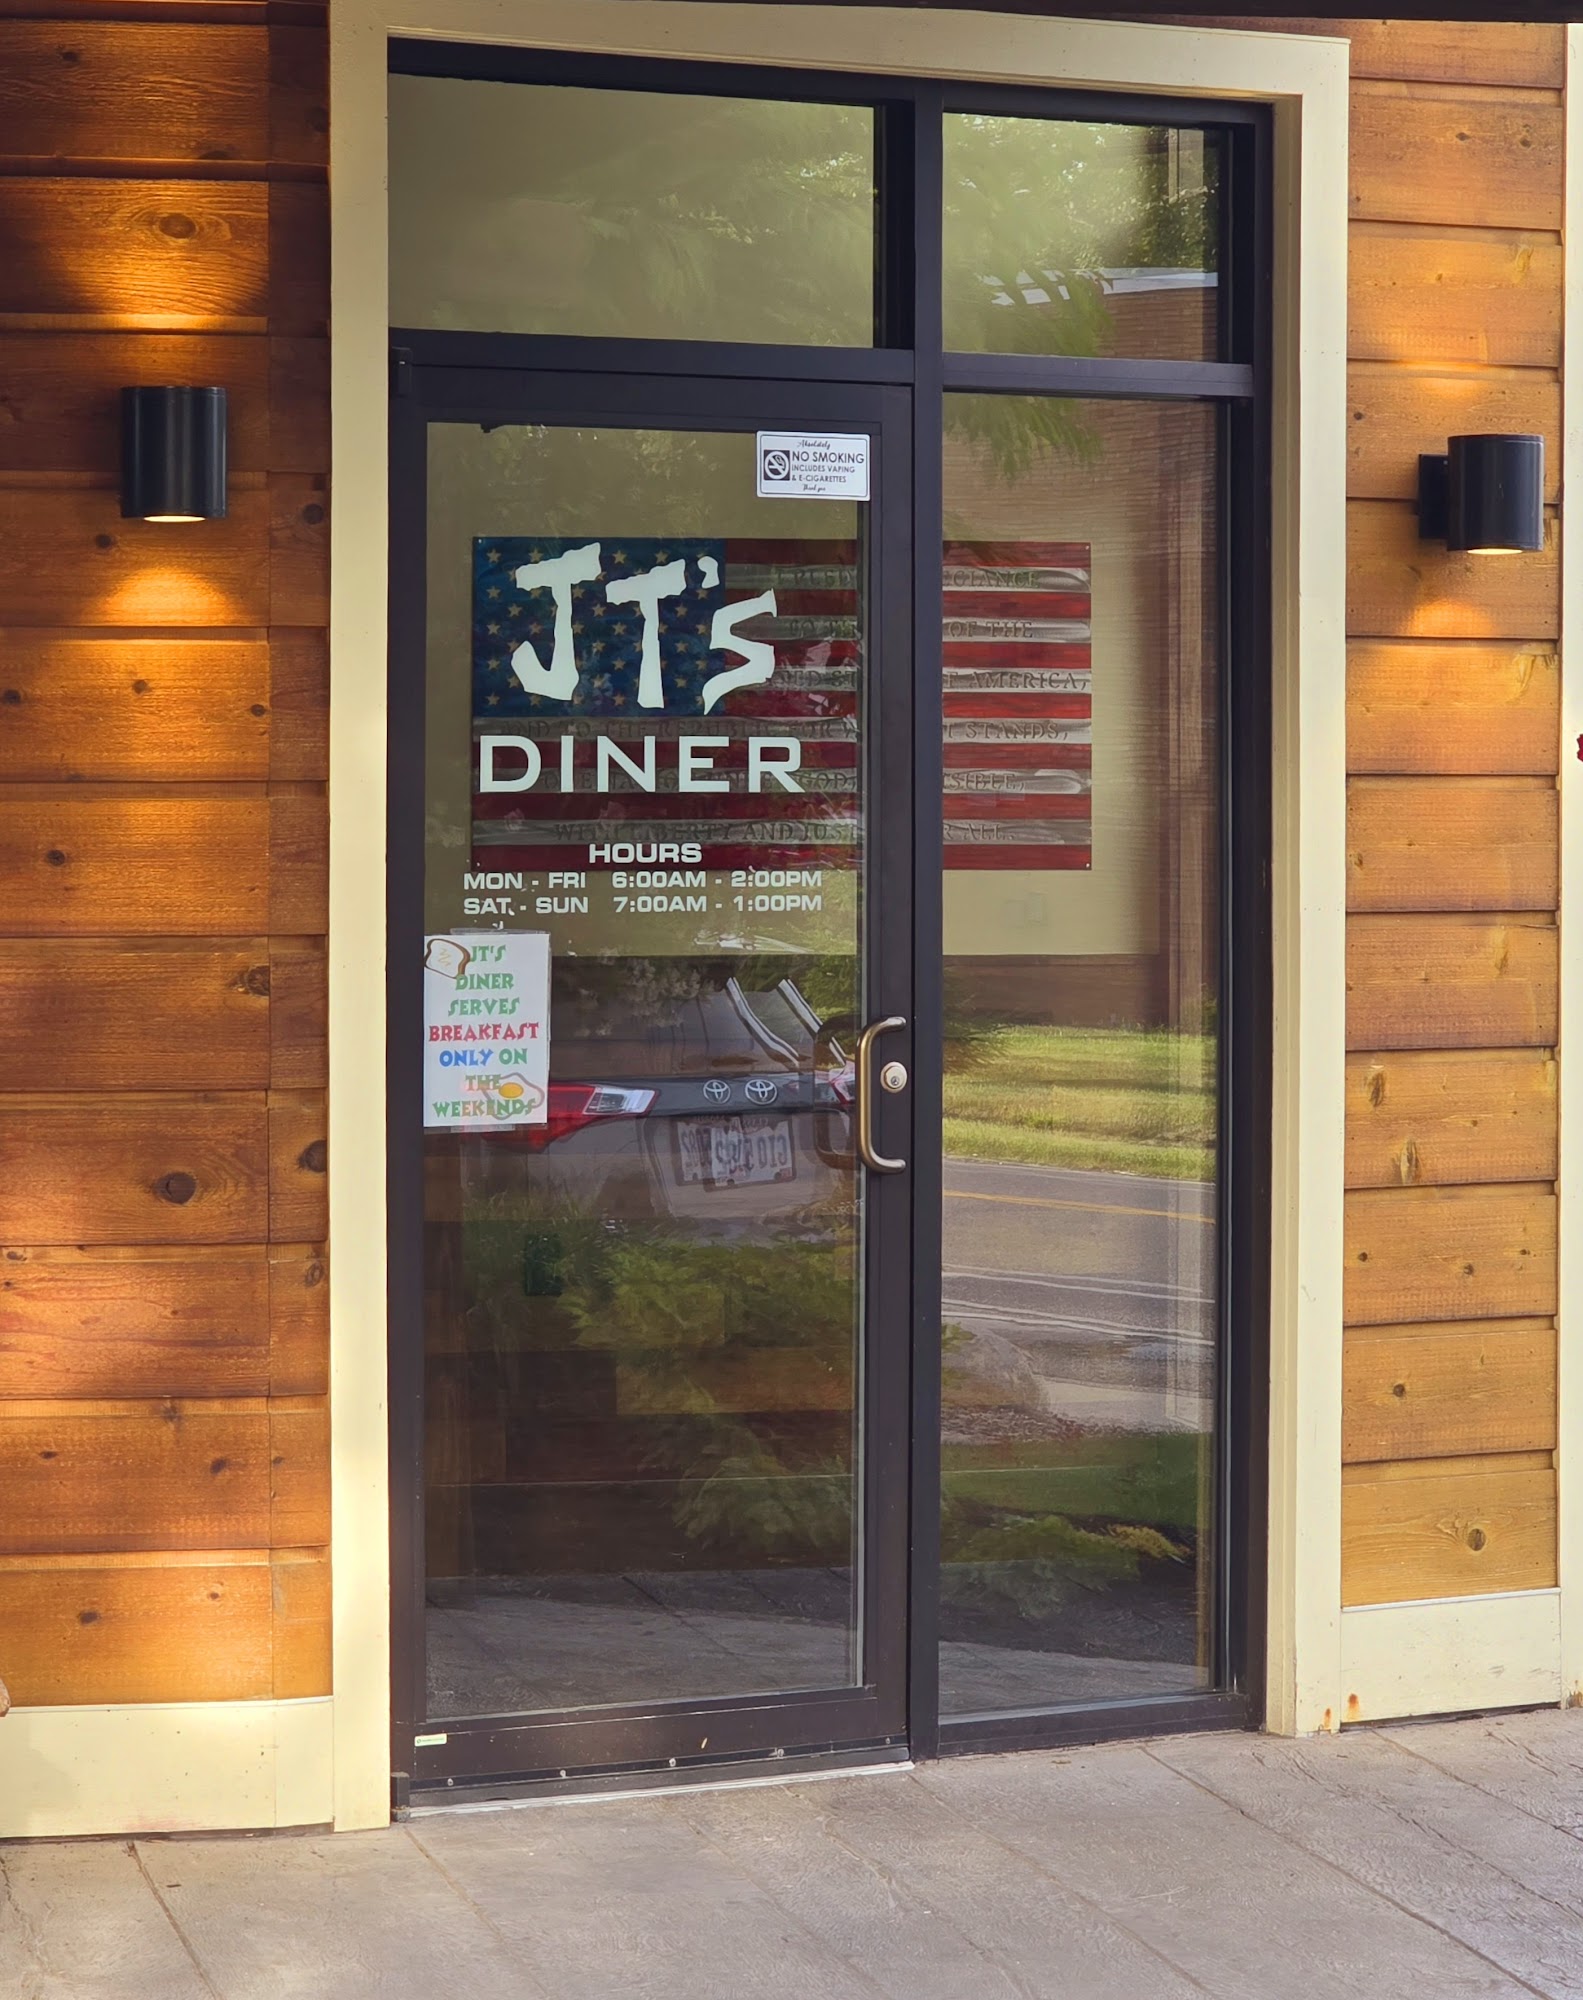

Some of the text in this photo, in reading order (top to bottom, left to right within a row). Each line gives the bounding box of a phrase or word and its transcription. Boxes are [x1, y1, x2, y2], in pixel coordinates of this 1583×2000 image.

[792, 450, 865, 464] NO SMOKING
[791, 464, 855, 473] INCLUDES VAPING
[799, 474, 847, 483] E-CIGARETTES
[511, 542, 778, 716] JT'S
[948, 620, 1033, 639] OF THE
[973, 671, 1087, 691] AMERICA,
[965, 722, 1068, 740] STANDS,
[479, 735, 806, 794] DINER
[741, 822, 795, 841] AND
[588, 843, 703, 864] HOURS
[464, 872, 523, 889] MON
[548, 872, 586, 888] FRI
[612, 871, 706, 888] 6:00AM
[731, 870, 823, 888] 2:00PM
[535, 897, 588, 914] SUN
[613, 896, 707, 913] 7:00AM
[734, 895, 823, 912] 1:00PM
[469, 944, 507, 963] JT'S
[455, 972, 515, 991] DINER
[448, 997, 520, 1017] SERVES
[428, 1022, 540, 1043] BREAKFAST
[438, 1048, 528, 1068] ONLY ON
[465, 1073, 502, 1093] THE
[432, 1097, 537, 1119] WEEKENDS
